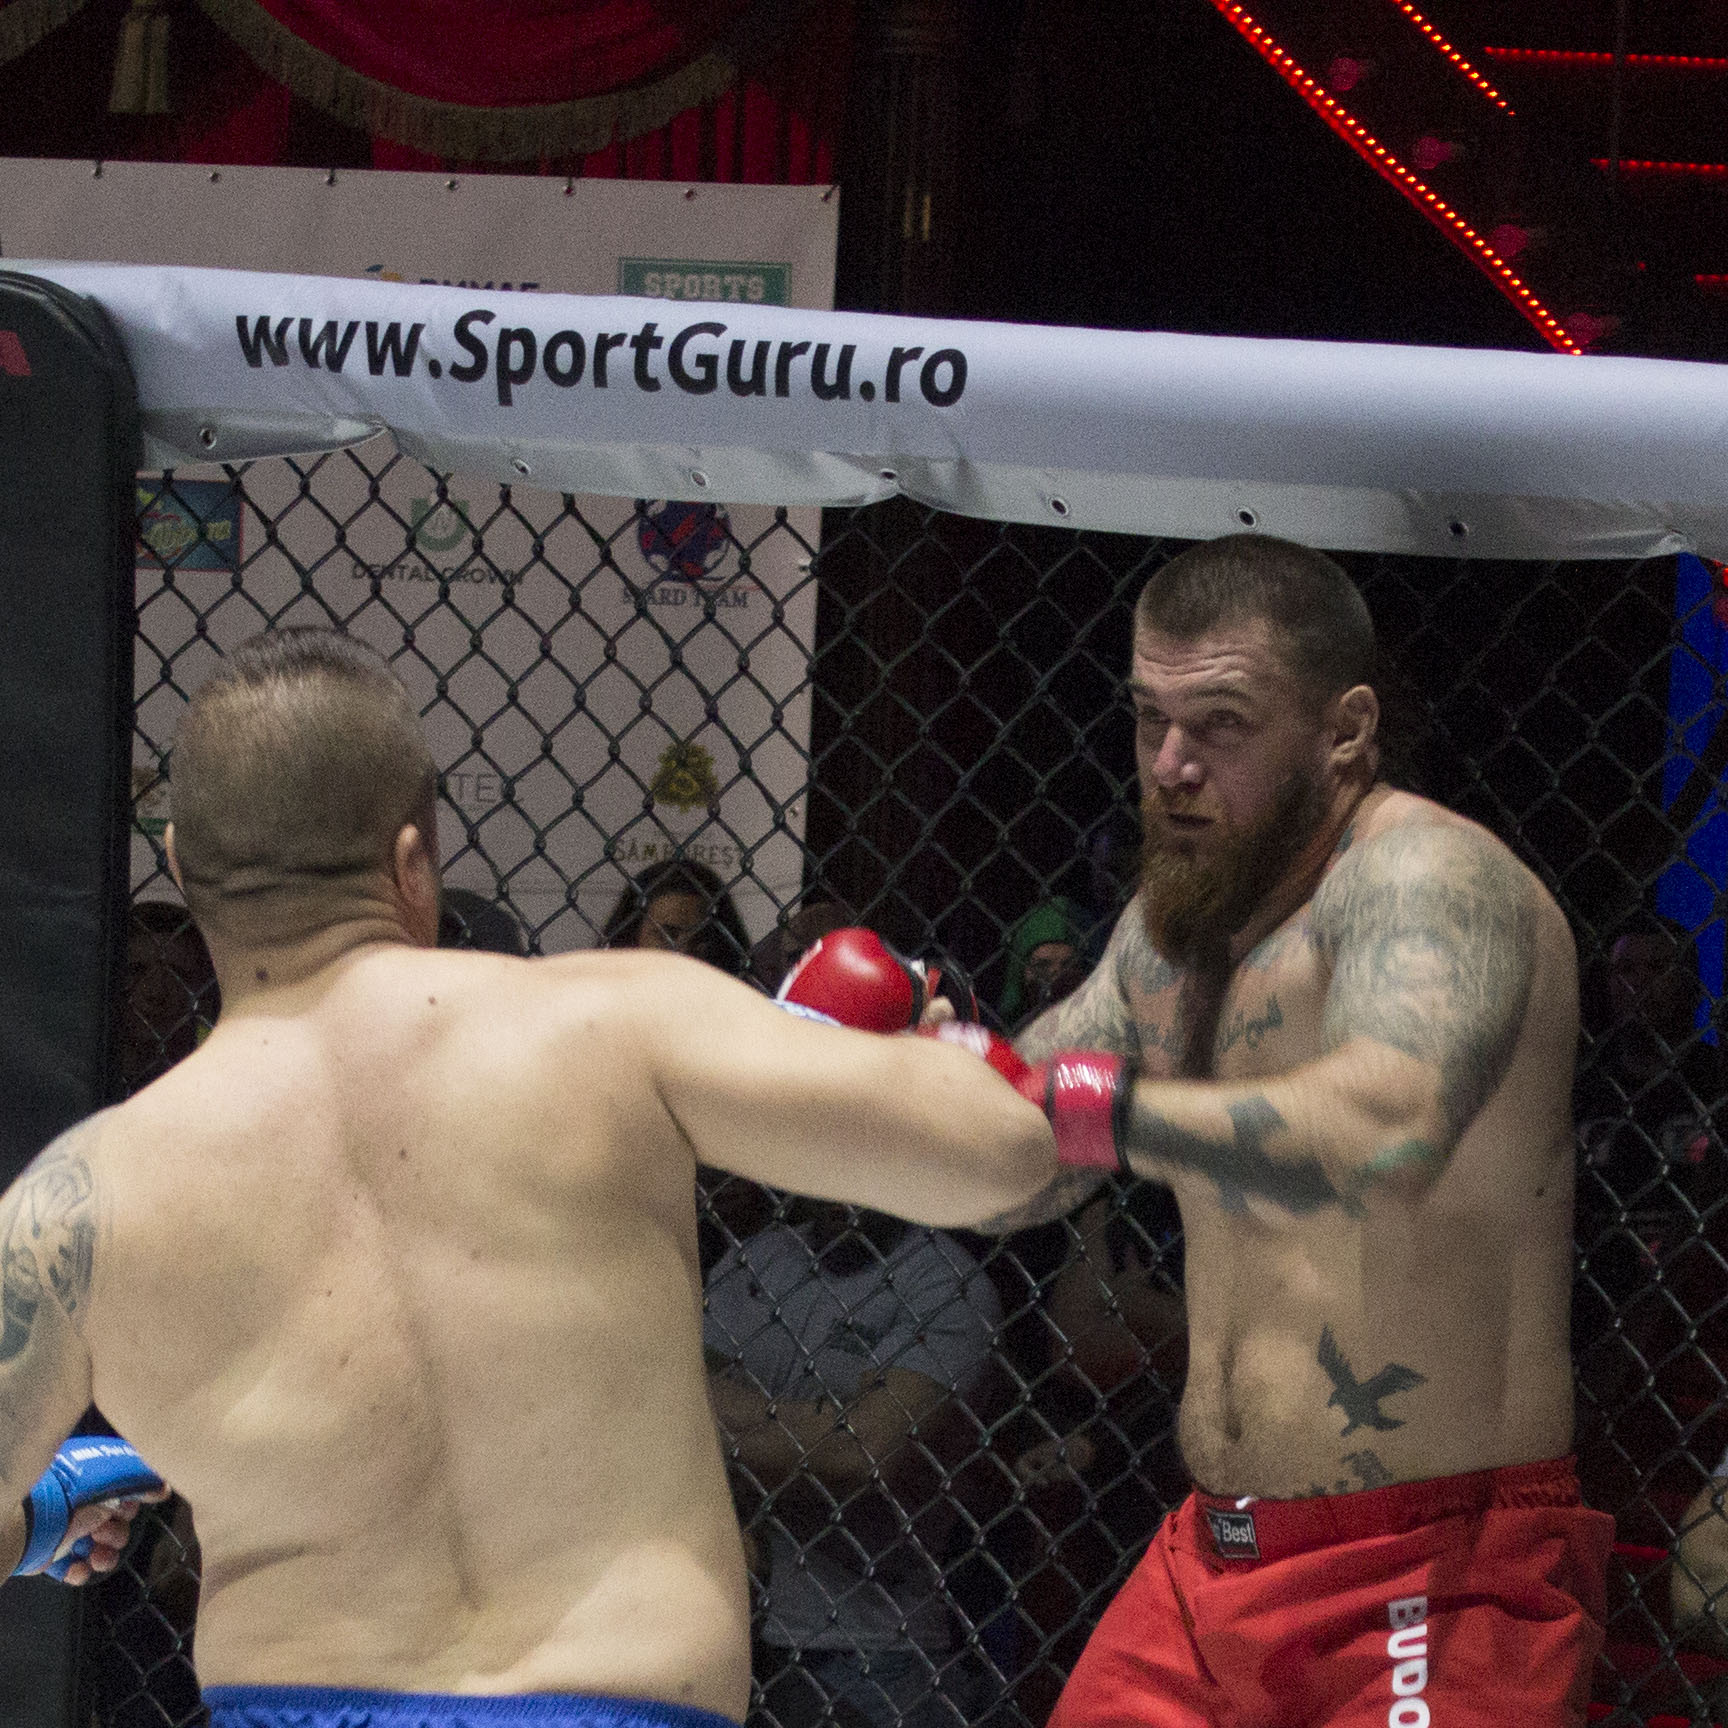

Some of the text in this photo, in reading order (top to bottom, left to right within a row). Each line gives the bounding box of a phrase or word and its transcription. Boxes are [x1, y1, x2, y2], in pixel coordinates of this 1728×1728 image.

[644, 270, 766, 301] SPORTS
[235, 308, 969, 408] www.SportGuru.ro
[693, 589, 749, 609] TAM
